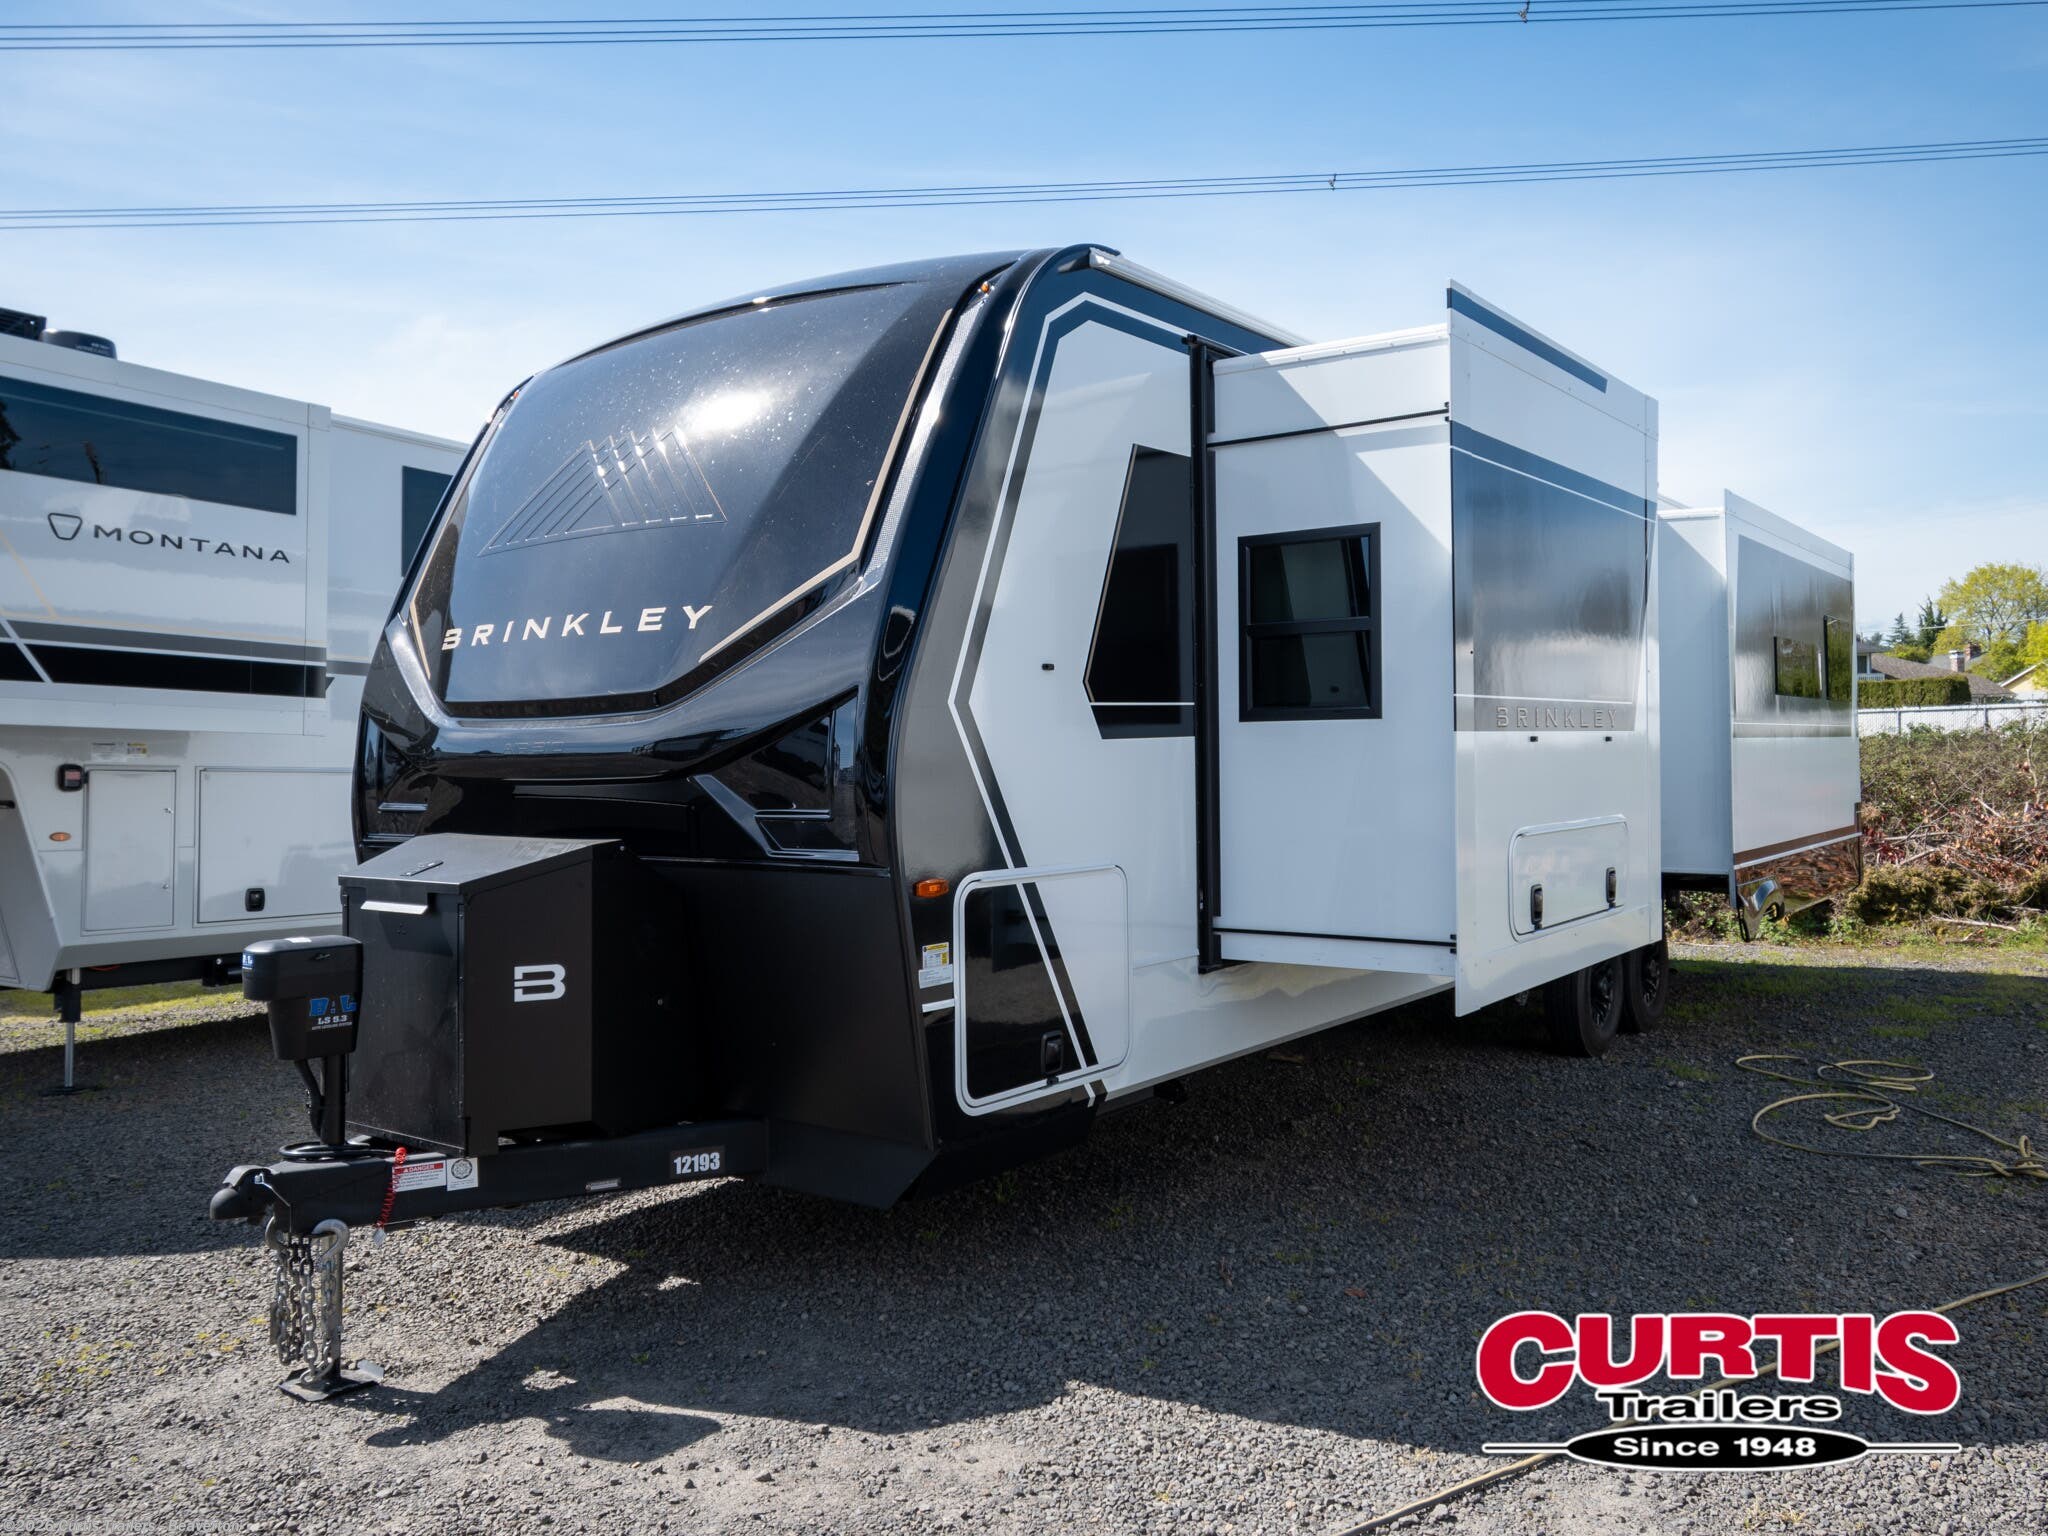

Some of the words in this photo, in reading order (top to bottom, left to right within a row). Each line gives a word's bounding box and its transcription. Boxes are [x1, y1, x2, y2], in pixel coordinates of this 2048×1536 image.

[94, 525, 290, 564] MONTANA
[441, 605, 713, 650] BRINKLEY
[1496, 706, 1617, 729] BRINKLEY
[514, 963, 566, 1002] B
[408, 1164, 434, 1173] DANGER
[674, 1152, 721, 1175] 12193
